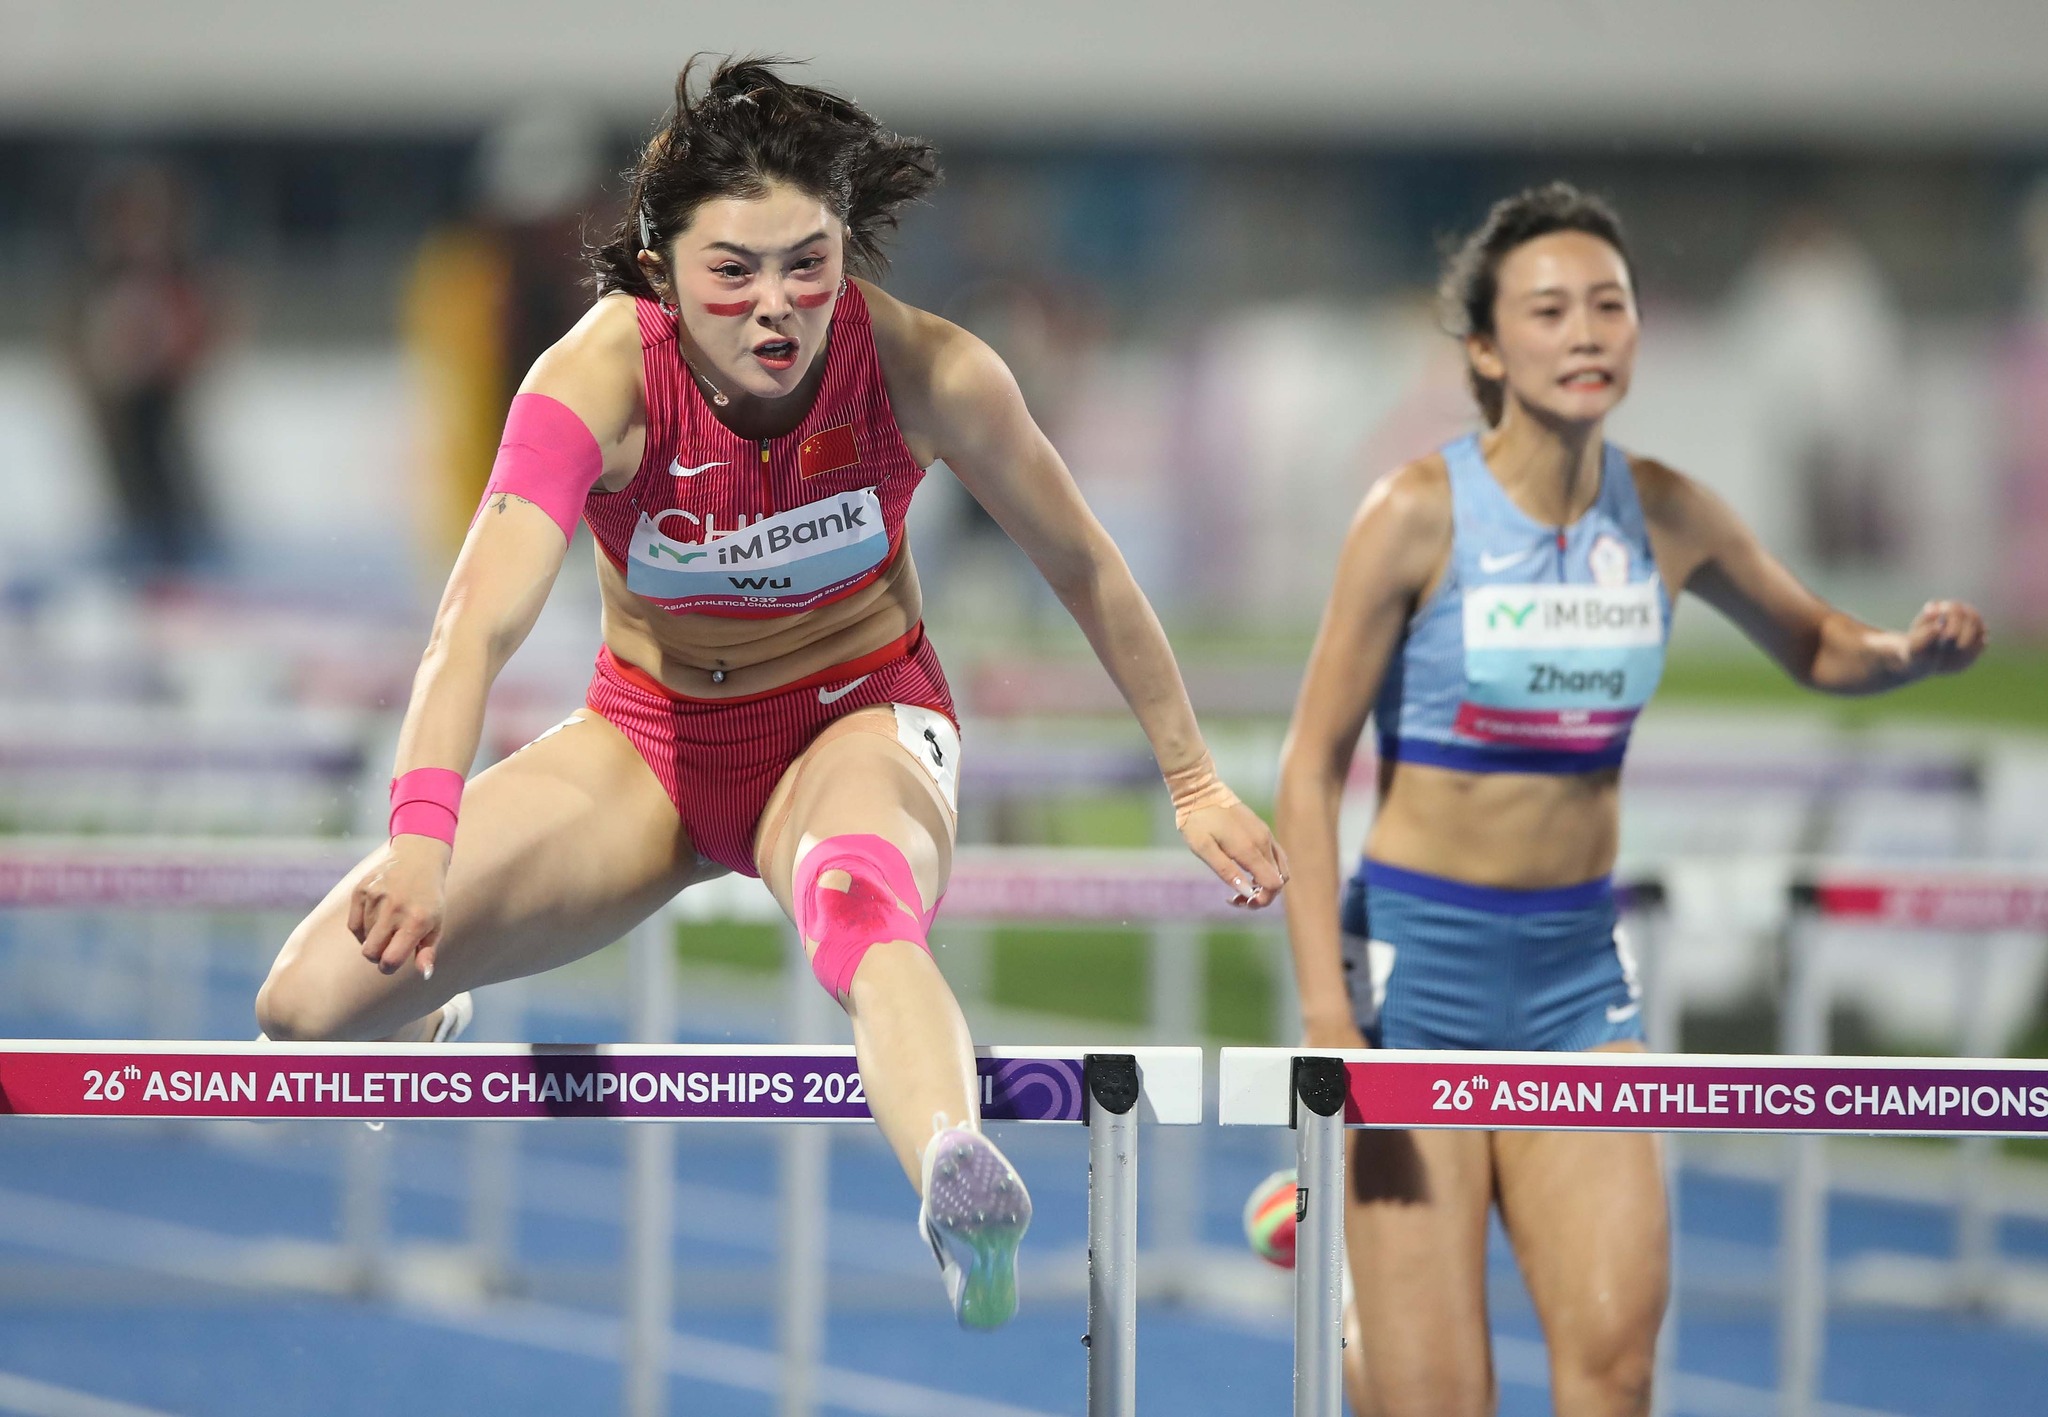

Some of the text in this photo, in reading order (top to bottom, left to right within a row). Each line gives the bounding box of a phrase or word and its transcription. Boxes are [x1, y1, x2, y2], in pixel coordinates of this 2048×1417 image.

[727, 576, 792, 590] Wu
[663, 602, 693, 611] ASIAN
[694, 600, 746, 608] ATHLETICS
[747, 591, 824, 609] CHAMPIONSHIPS
[742, 596, 778, 604] 1039
[1528, 664, 1625, 700] Zhang
[142, 1071, 257, 1102] ASIAN
[266, 1072, 473, 1104] ATHLETICS
[481, 1071, 794, 1104] CHAMPIONSHIPS
[803, 1072, 867, 1104] 202
[1490, 1080, 1603, 1112] ASIAN
[1612, 1082, 1816, 1116] ATHLETICS
